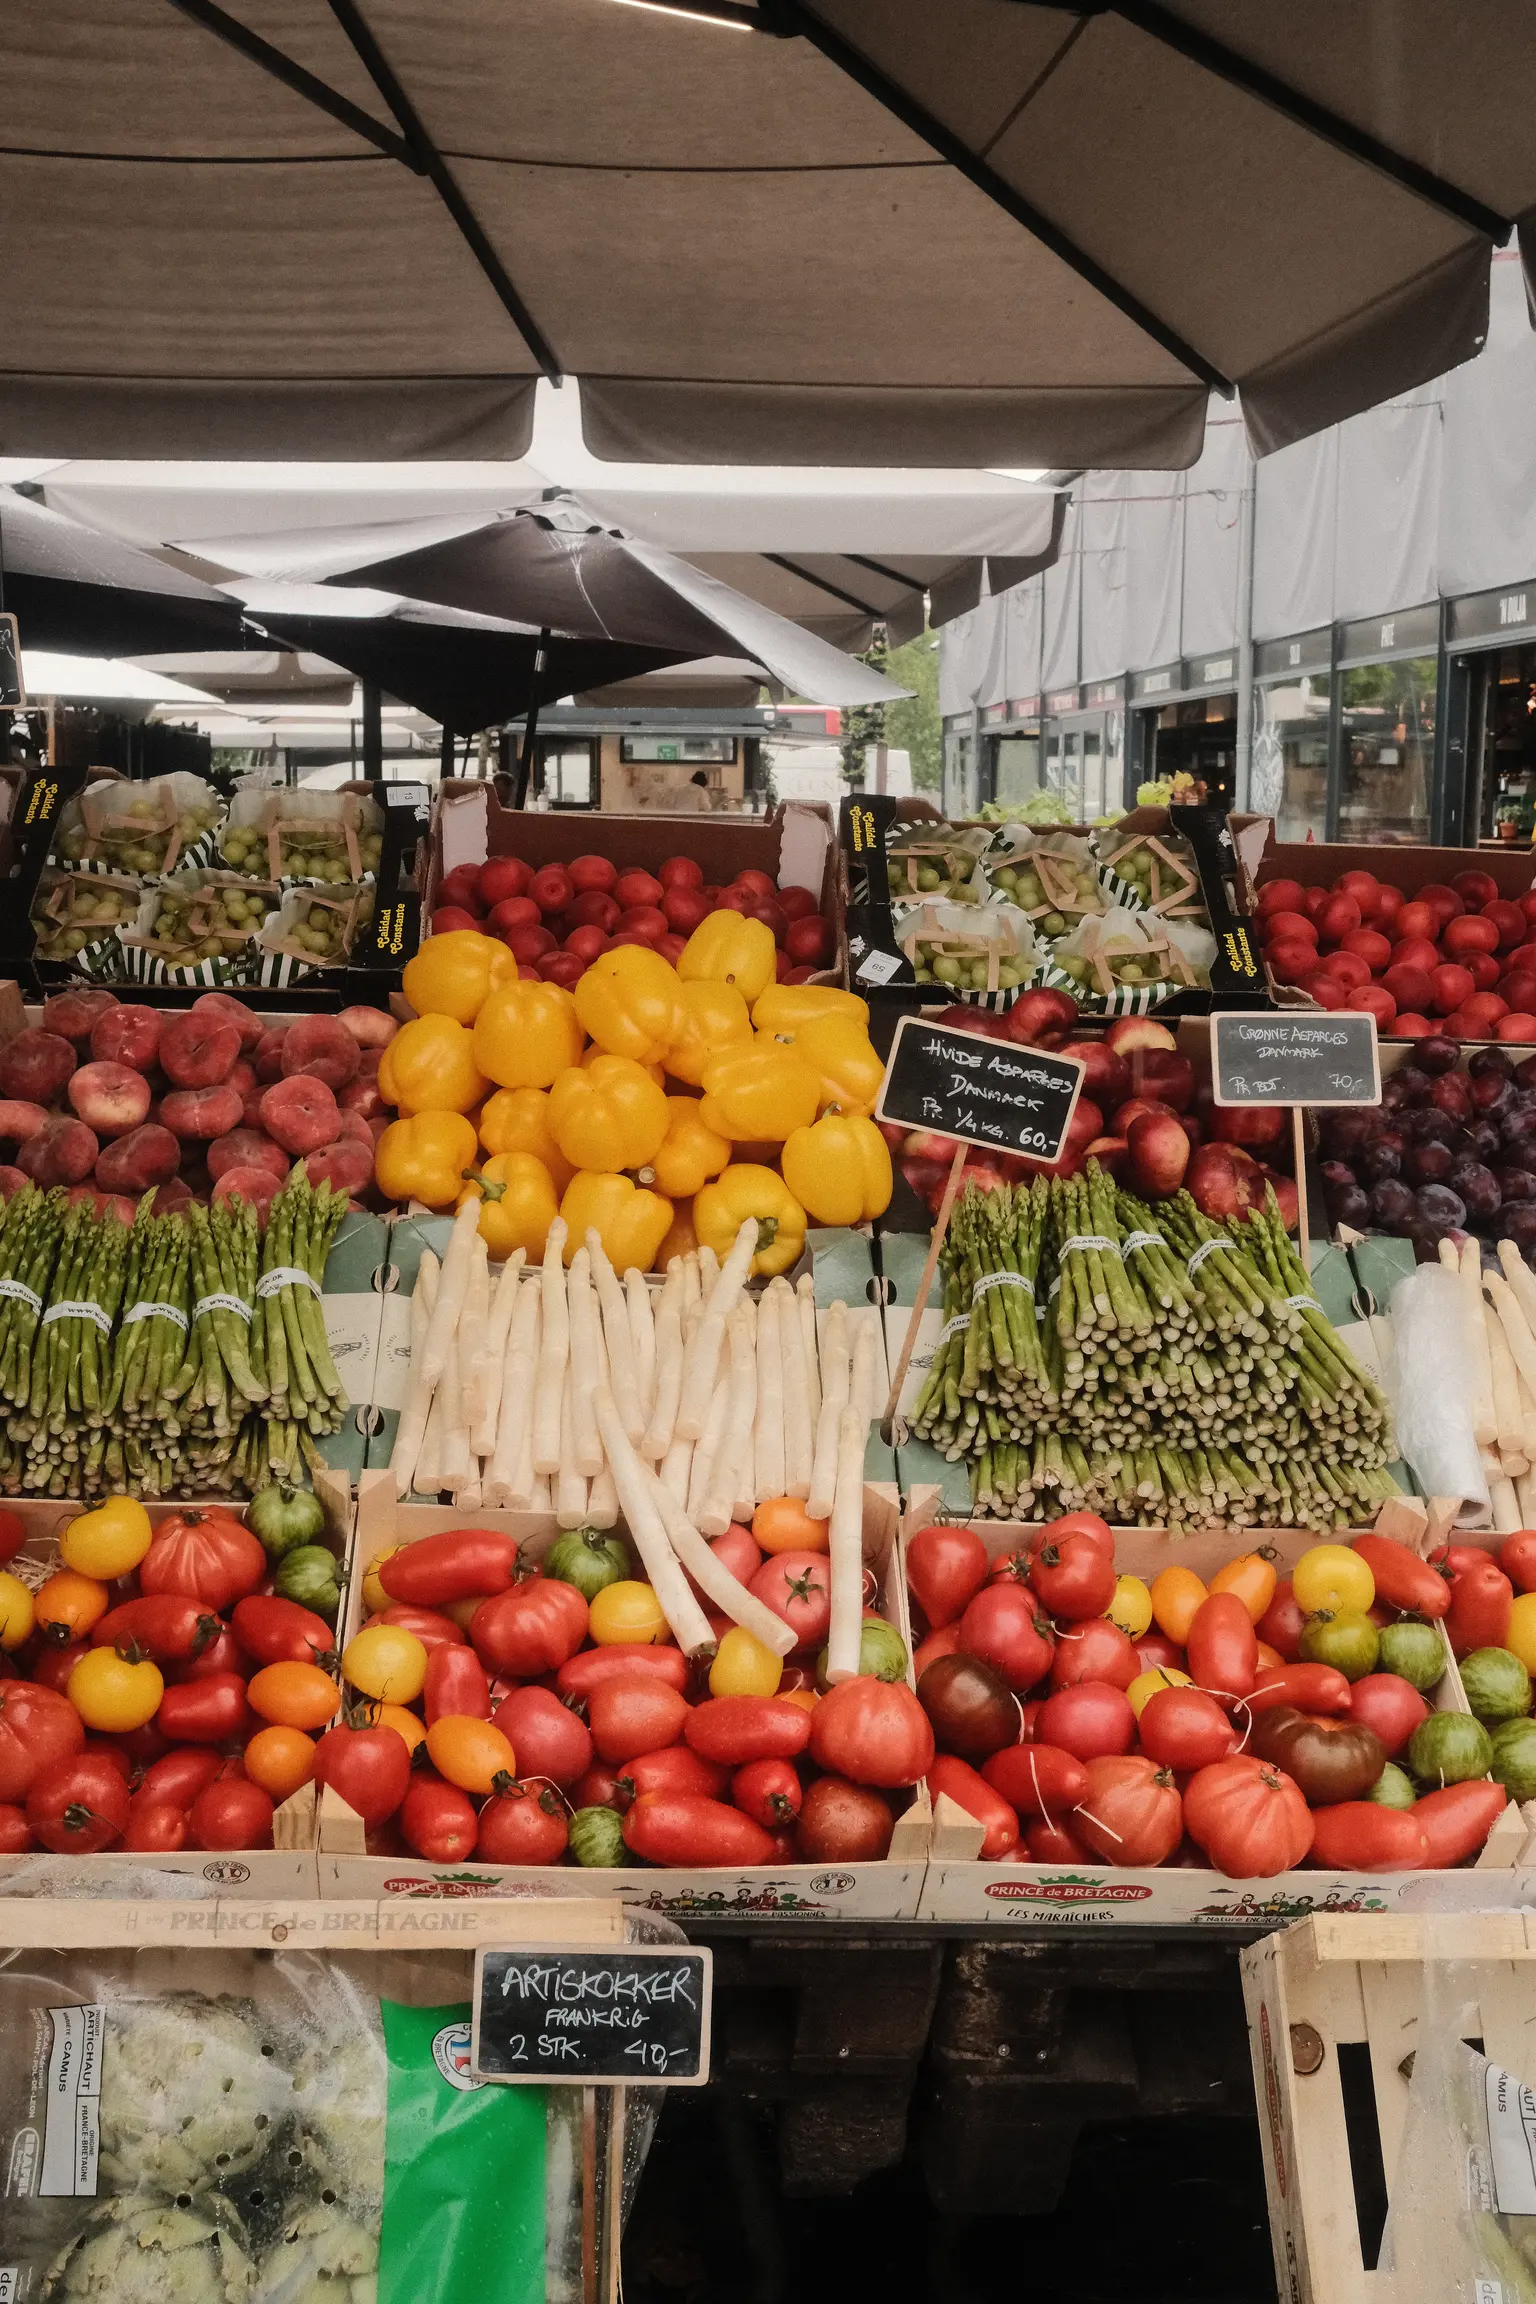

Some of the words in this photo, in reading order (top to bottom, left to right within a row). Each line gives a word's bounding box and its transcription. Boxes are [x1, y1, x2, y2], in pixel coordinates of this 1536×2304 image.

[25, 778, 47, 824] Constante
[39, 783, 58, 819] Calidad
[850, 805, 862, 852] Constante
[862, 811, 877, 849] Calidad
[378, 908, 392, 949] Calidad
[390, 903, 406, 955] Constante
[1223, 933, 1243, 972] Calidad
[1237, 927, 1258, 978] Constante
[1238, 1024, 1290, 1041] GRØNNE
[1291, 1026, 1349, 1045] ASPARGES
[1256, 1045, 1324, 1060] DANMARK
[947, 1074, 1045, 1112] DANMARK
[955, 1106, 977, 1132] 1/4
[1019, 1126, 1059, 1152] 60,-
[989, 1886, 1044, 1896] PRINCE
[1046, 1888, 1061, 1896] de
[1064, 1888, 1147, 1899] BRETAGNE
[170, 1912, 280, 1931] PRINCE
[282, 1912, 317, 1932] de
[321, 1912, 478, 1932] BRETAGNE
[1007, 1908, 1028, 1919] LES
[1033, 1910, 1114, 1922] MARAÎCHERS
[58, 2040, 73, 2093] CAMUS
[82, 2010, 95, 2091] ARTICHAUT
[434, 2043, 451, 2076] BRETAGNE
[509, 2034, 529, 2060] 2
[538, 2034, 587, 2060] STK.
[624, 2039, 689, 2074] 40,-
[1498, 2070, 1508, 2113] AMUS
[80, 2105, 89, 2183] FRANCE-BRETAGNE
